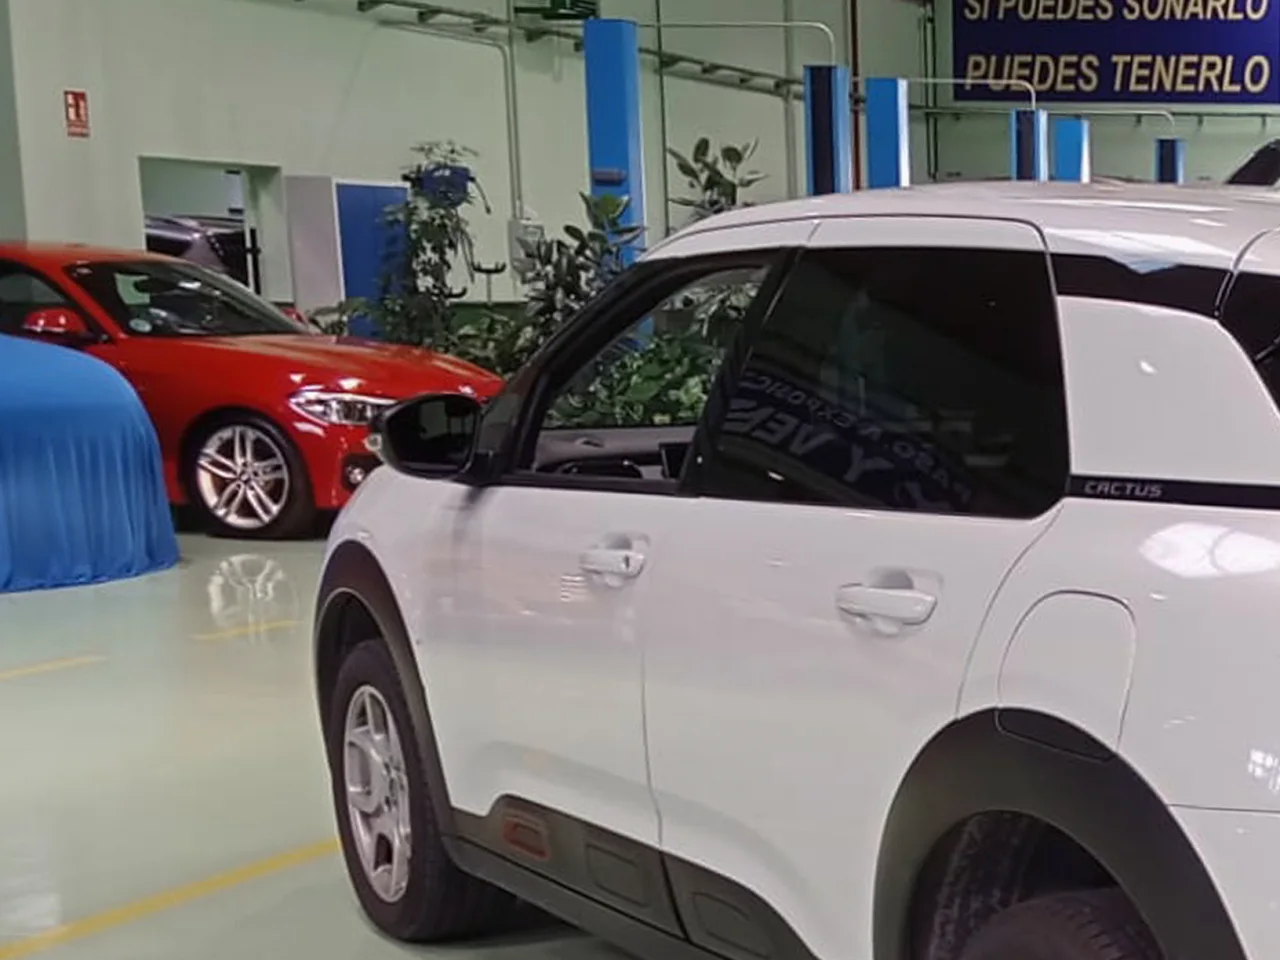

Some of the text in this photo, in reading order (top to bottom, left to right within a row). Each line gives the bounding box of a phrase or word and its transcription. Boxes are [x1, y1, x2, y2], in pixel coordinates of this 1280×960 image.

[964, 54, 1270, 93] PUEDES TENERLO
[1084, 480, 1163, 498] CACTUS
